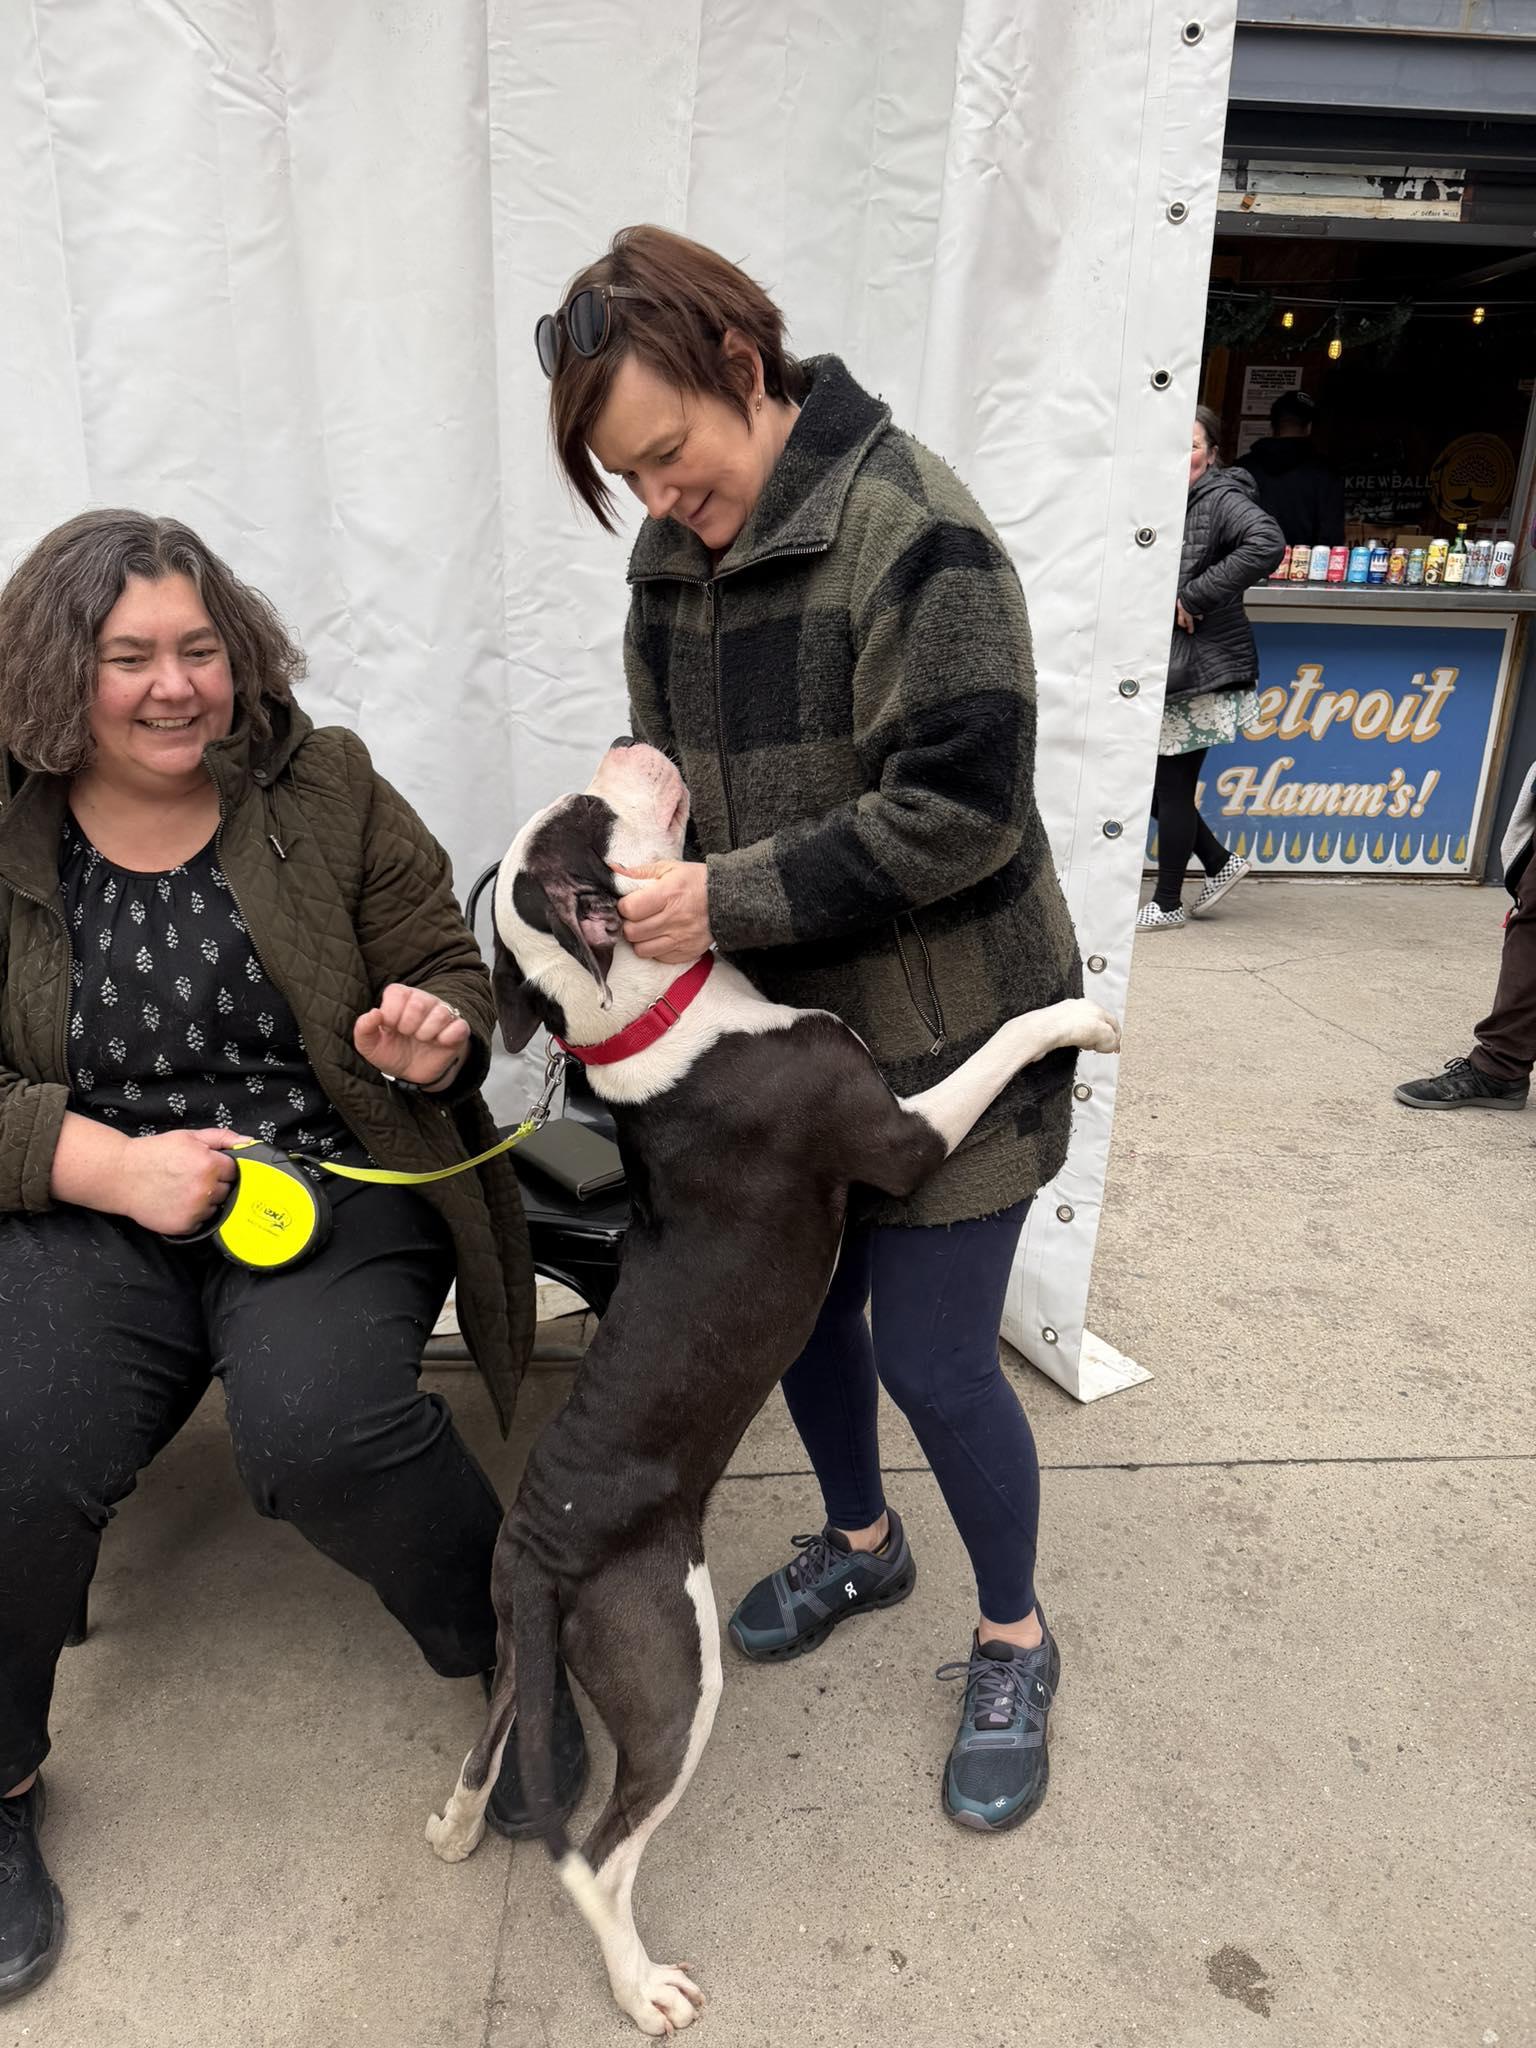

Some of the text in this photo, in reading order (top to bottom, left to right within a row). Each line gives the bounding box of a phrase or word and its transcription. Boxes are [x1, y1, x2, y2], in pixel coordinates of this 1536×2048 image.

[1342, 475, 1433, 489] KREWBALL
[1495, 551, 1513, 563] Lite
[1243, 664, 1461, 743] etroit
[1216, 756, 1441, 818] Hamm's!
